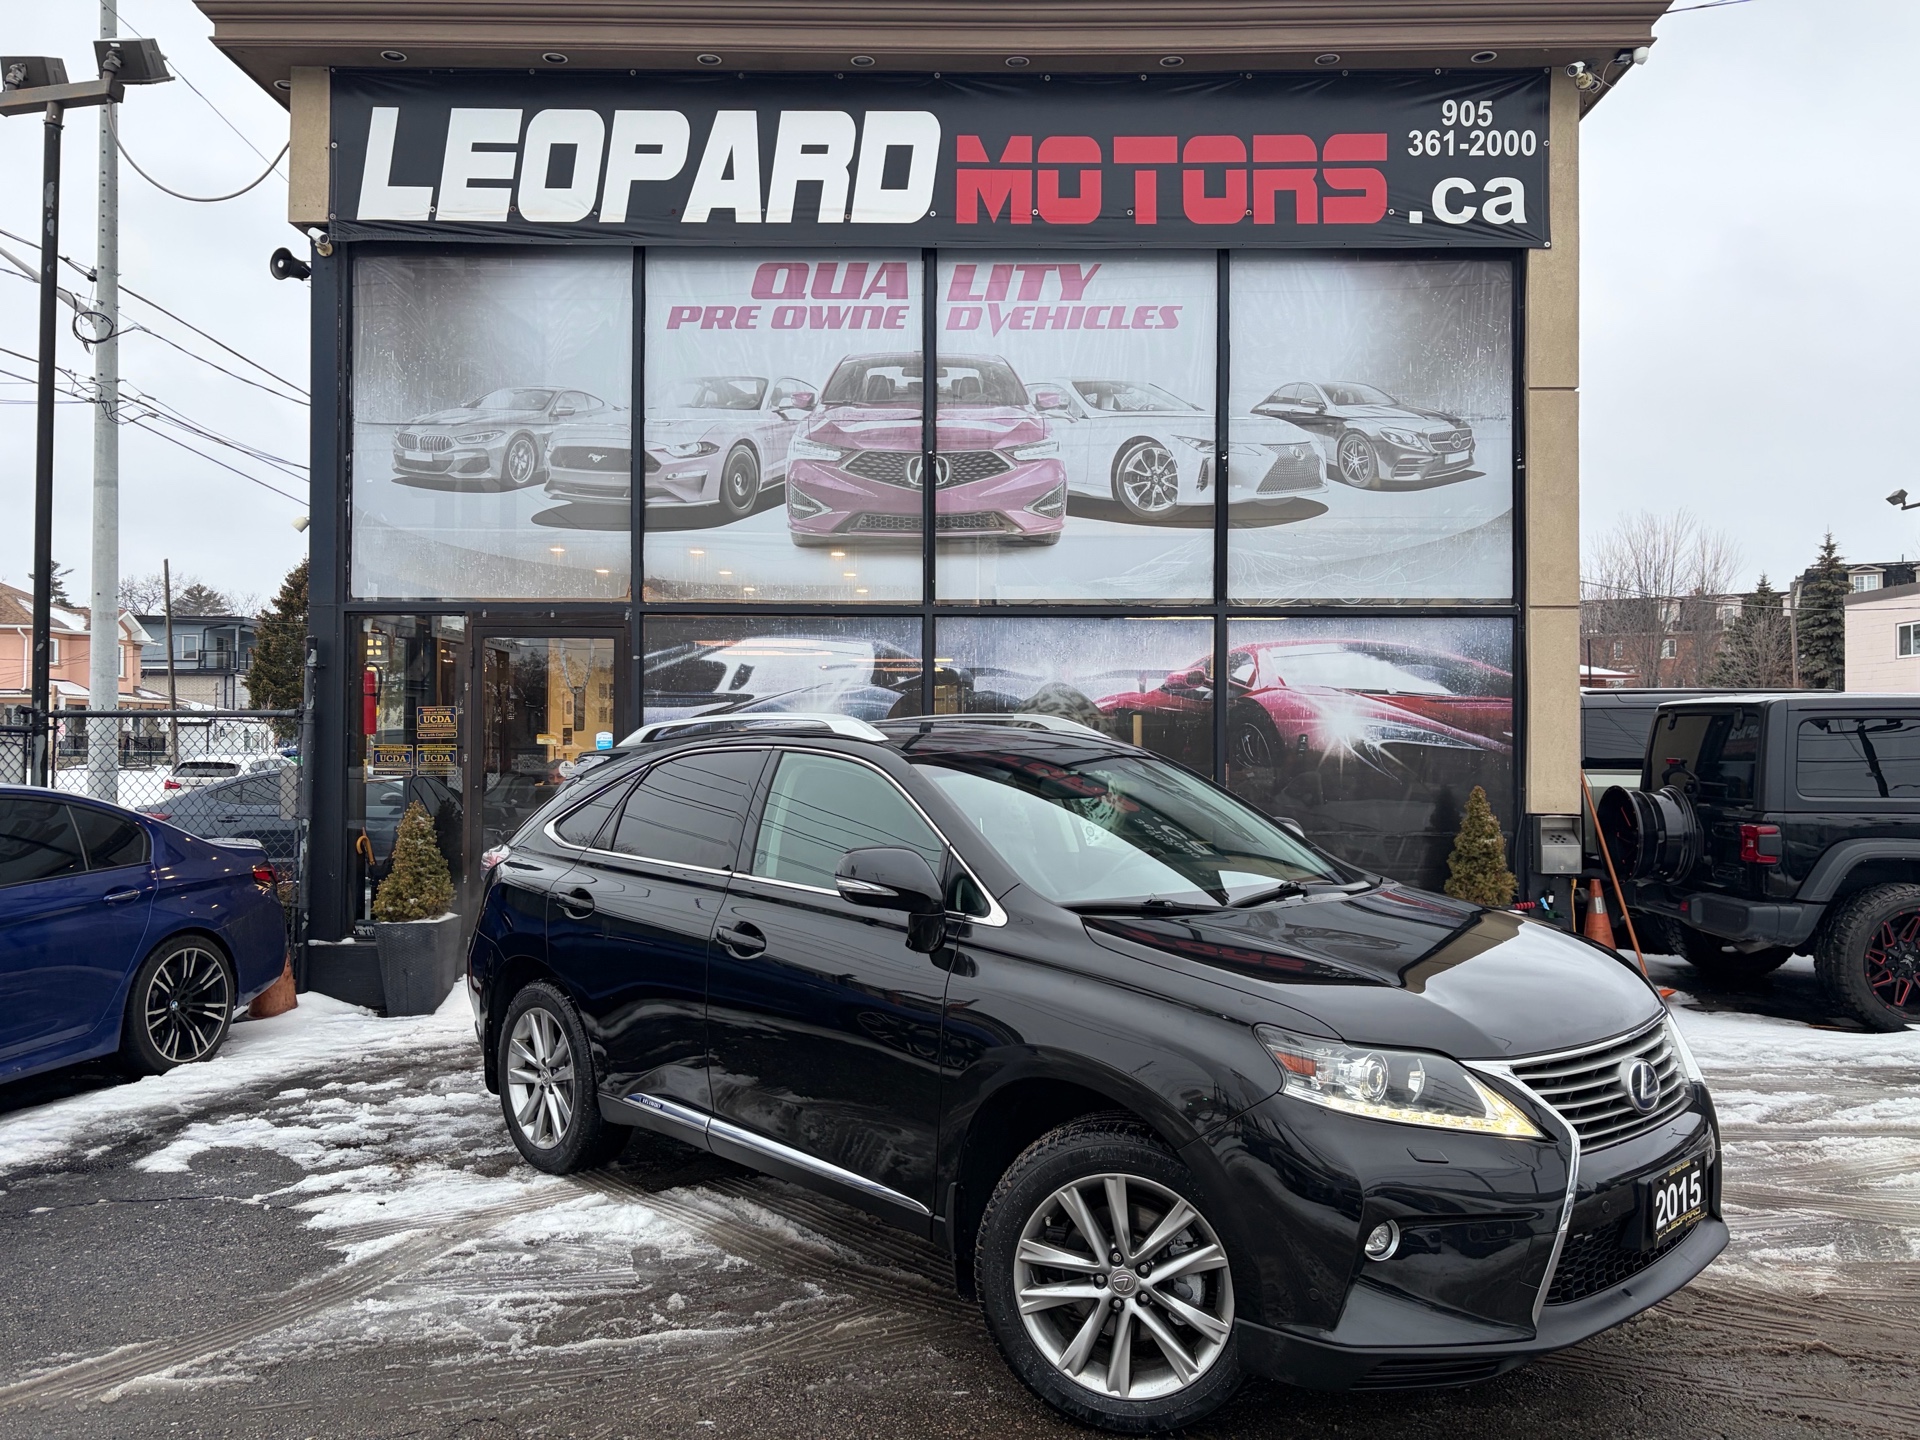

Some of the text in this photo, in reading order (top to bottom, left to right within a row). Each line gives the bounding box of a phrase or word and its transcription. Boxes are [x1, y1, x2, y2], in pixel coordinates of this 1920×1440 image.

[1441, 100, 1494, 128] 905
[1407, 129, 1537, 158] 361-2000
[356, 106, 1388, 225] LEOPARD MOTORS
[1408, 175, 1528, 225] .ca
[666, 305, 763, 330] PRE
[423, 715, 452, 724] UCDA
[379, 754, 407, 762] UCDA
[423, 754, 451, 762] UCDA
[1655, 1169, 1702, 1231] 2015
[1665, 1206, 1702, 1233] LEOPARD
